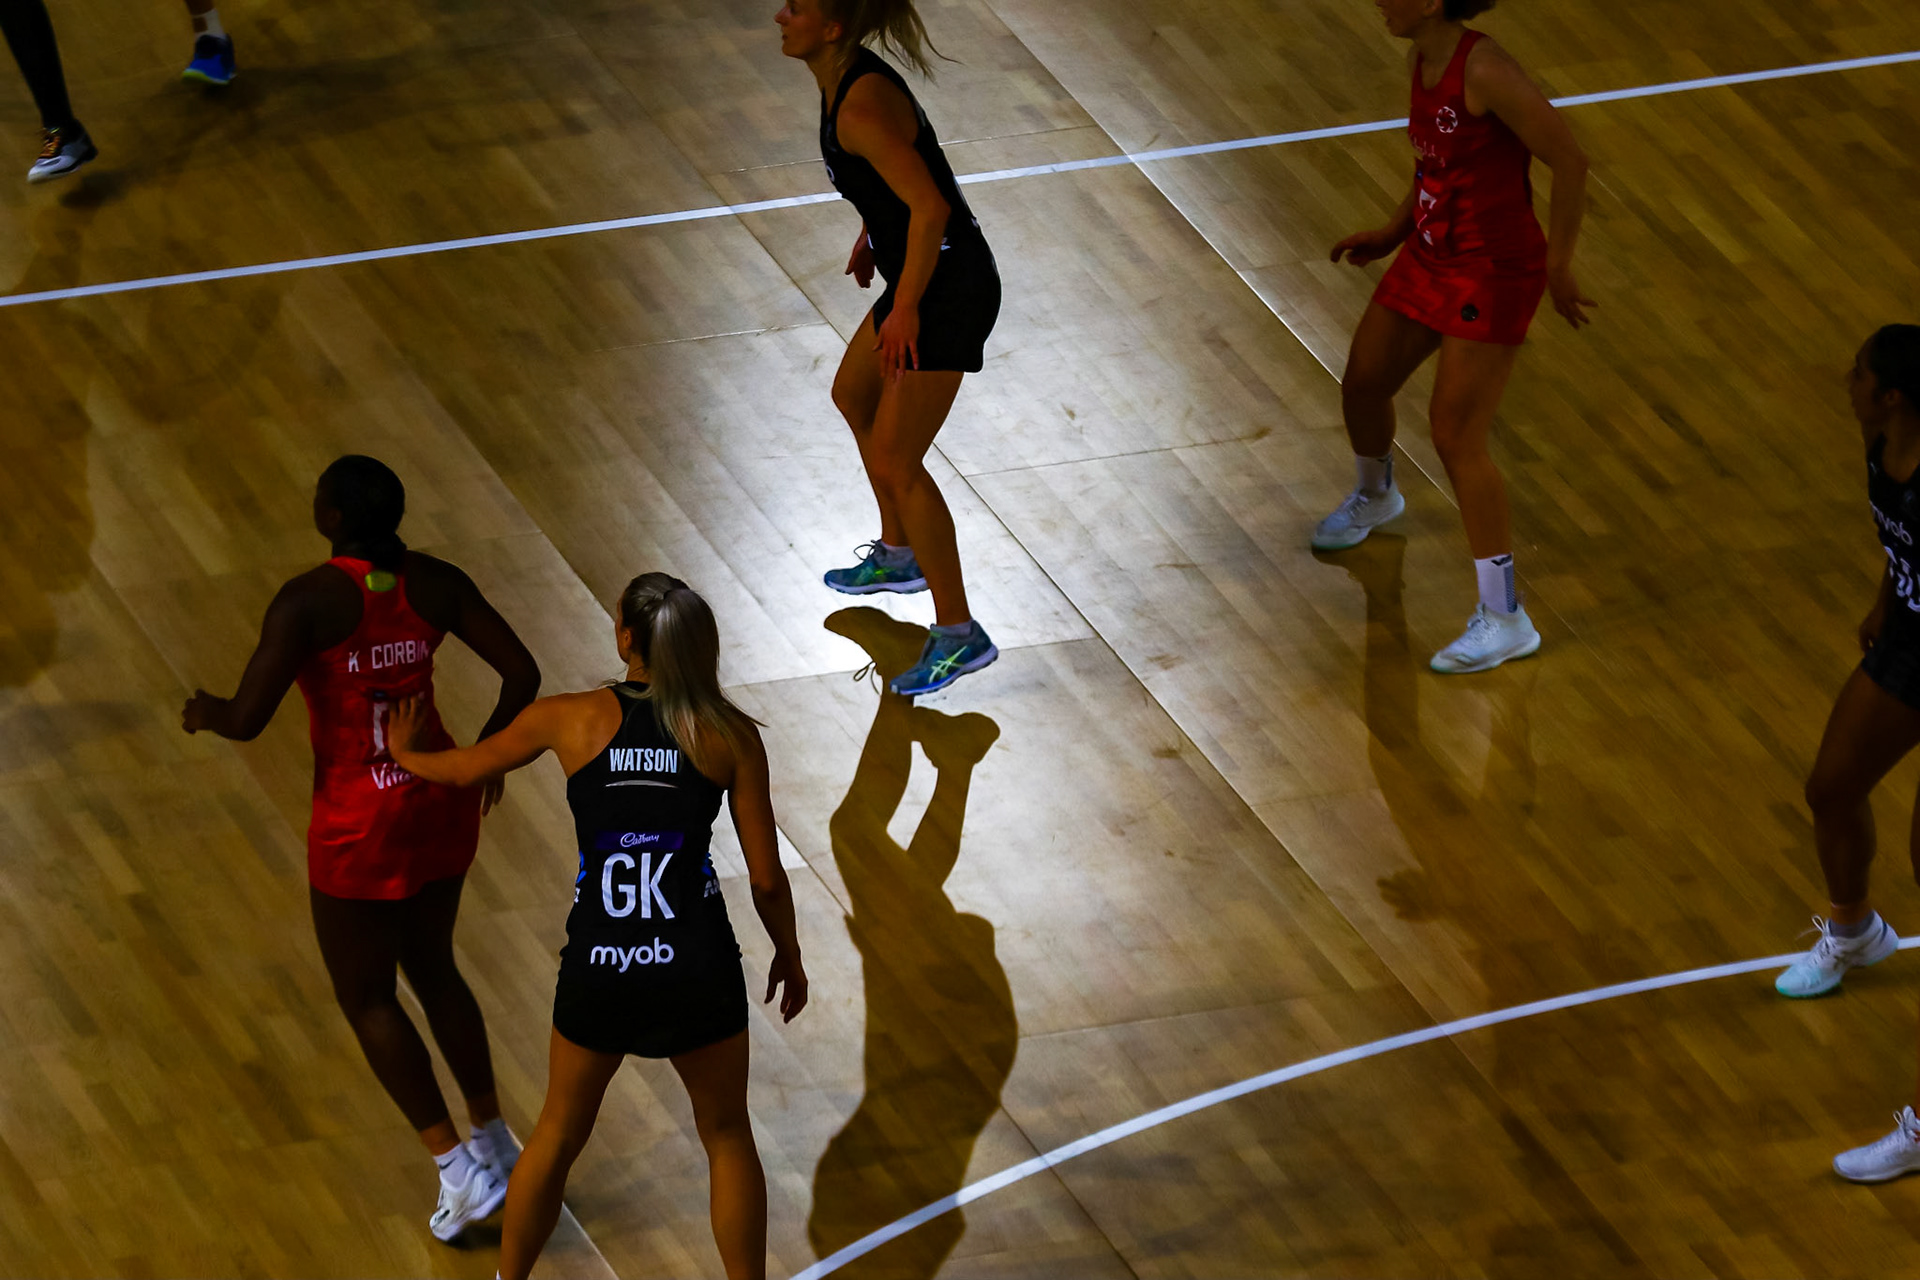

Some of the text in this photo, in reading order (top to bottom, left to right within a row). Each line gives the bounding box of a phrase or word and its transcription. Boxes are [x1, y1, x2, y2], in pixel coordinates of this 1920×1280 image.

[348, 650, 360, 673] K
[609, 748, 678, 773] WATSON
[620, 832, 660, 847] Cadbury
[602, 853, 675, 919] GK
[590, 937, 675, 973] myob
